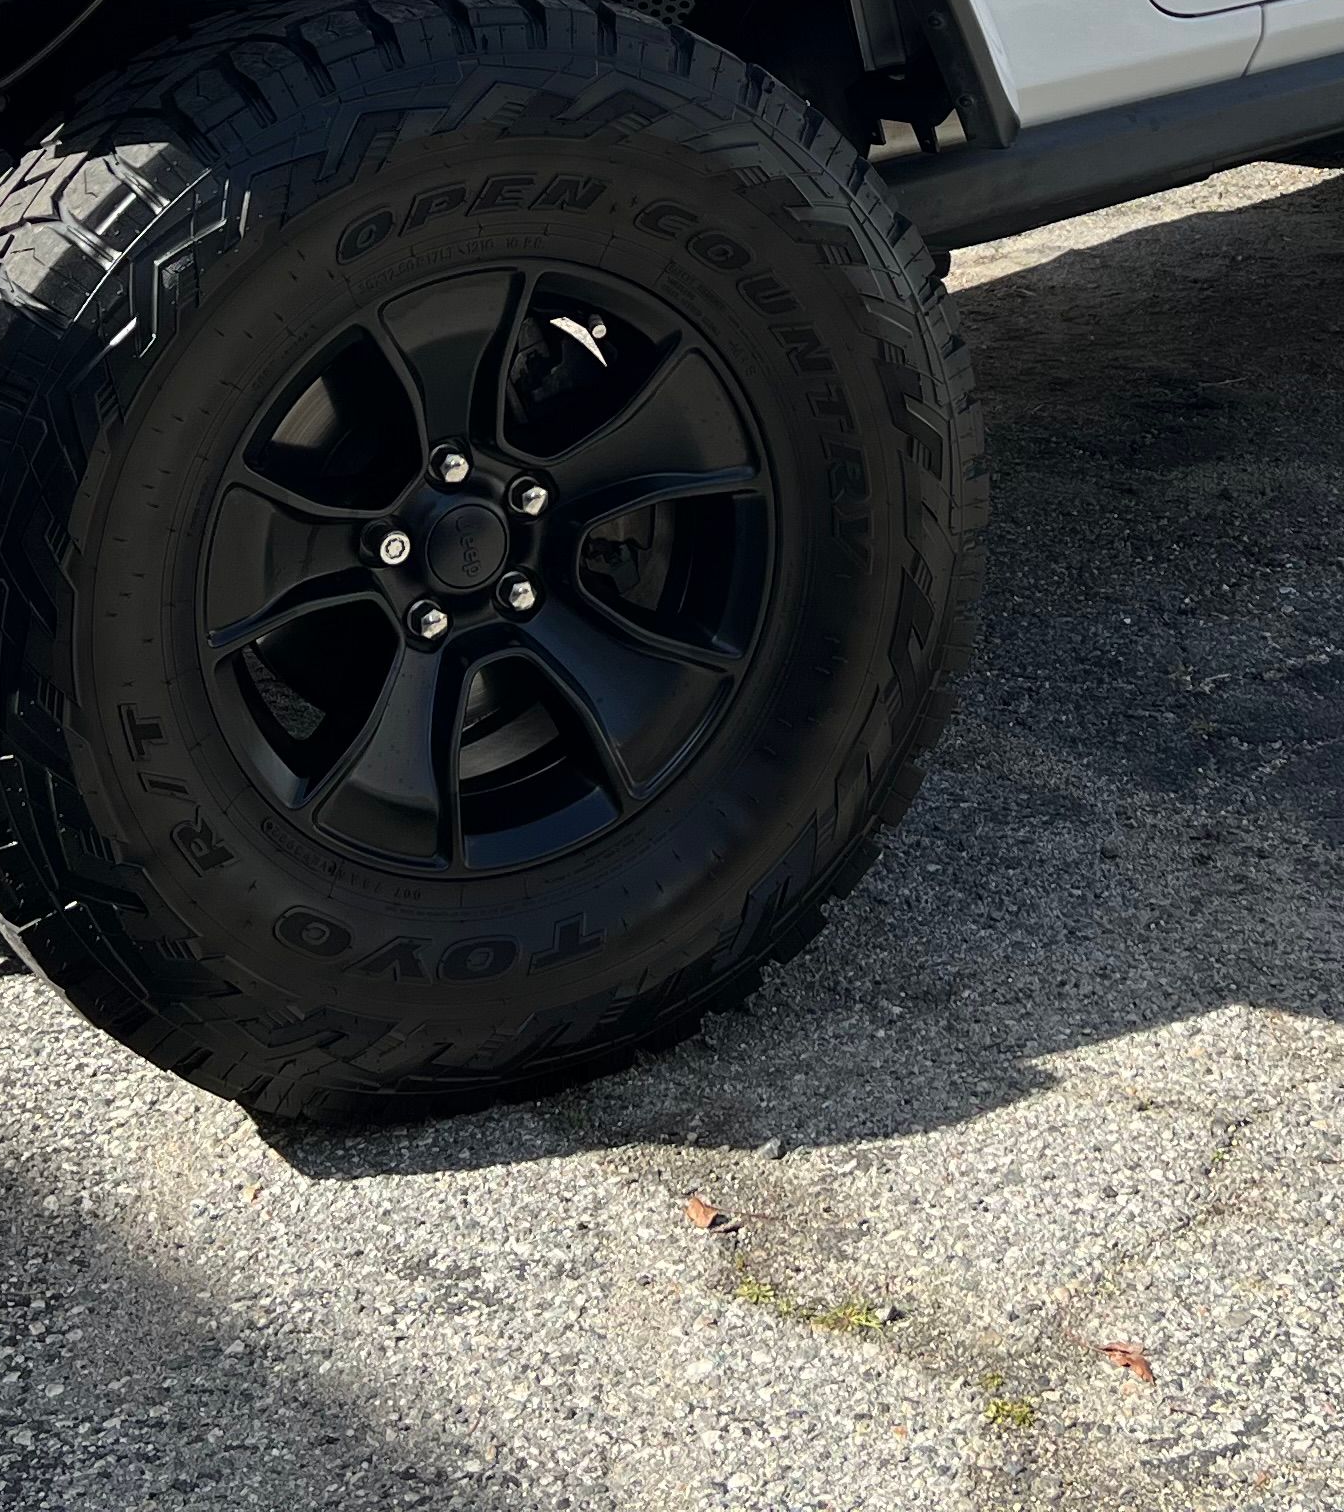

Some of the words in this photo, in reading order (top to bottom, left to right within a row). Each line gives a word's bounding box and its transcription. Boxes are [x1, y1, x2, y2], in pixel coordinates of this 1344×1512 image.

[335, 172, 609, 265] OPEN
[633, 198, 875, 575] COUNTRY
[453, 514, 482, 578] Jeep
[117, 702, 241, 878] R/T
[273, 903, 608, 985] TOYO
